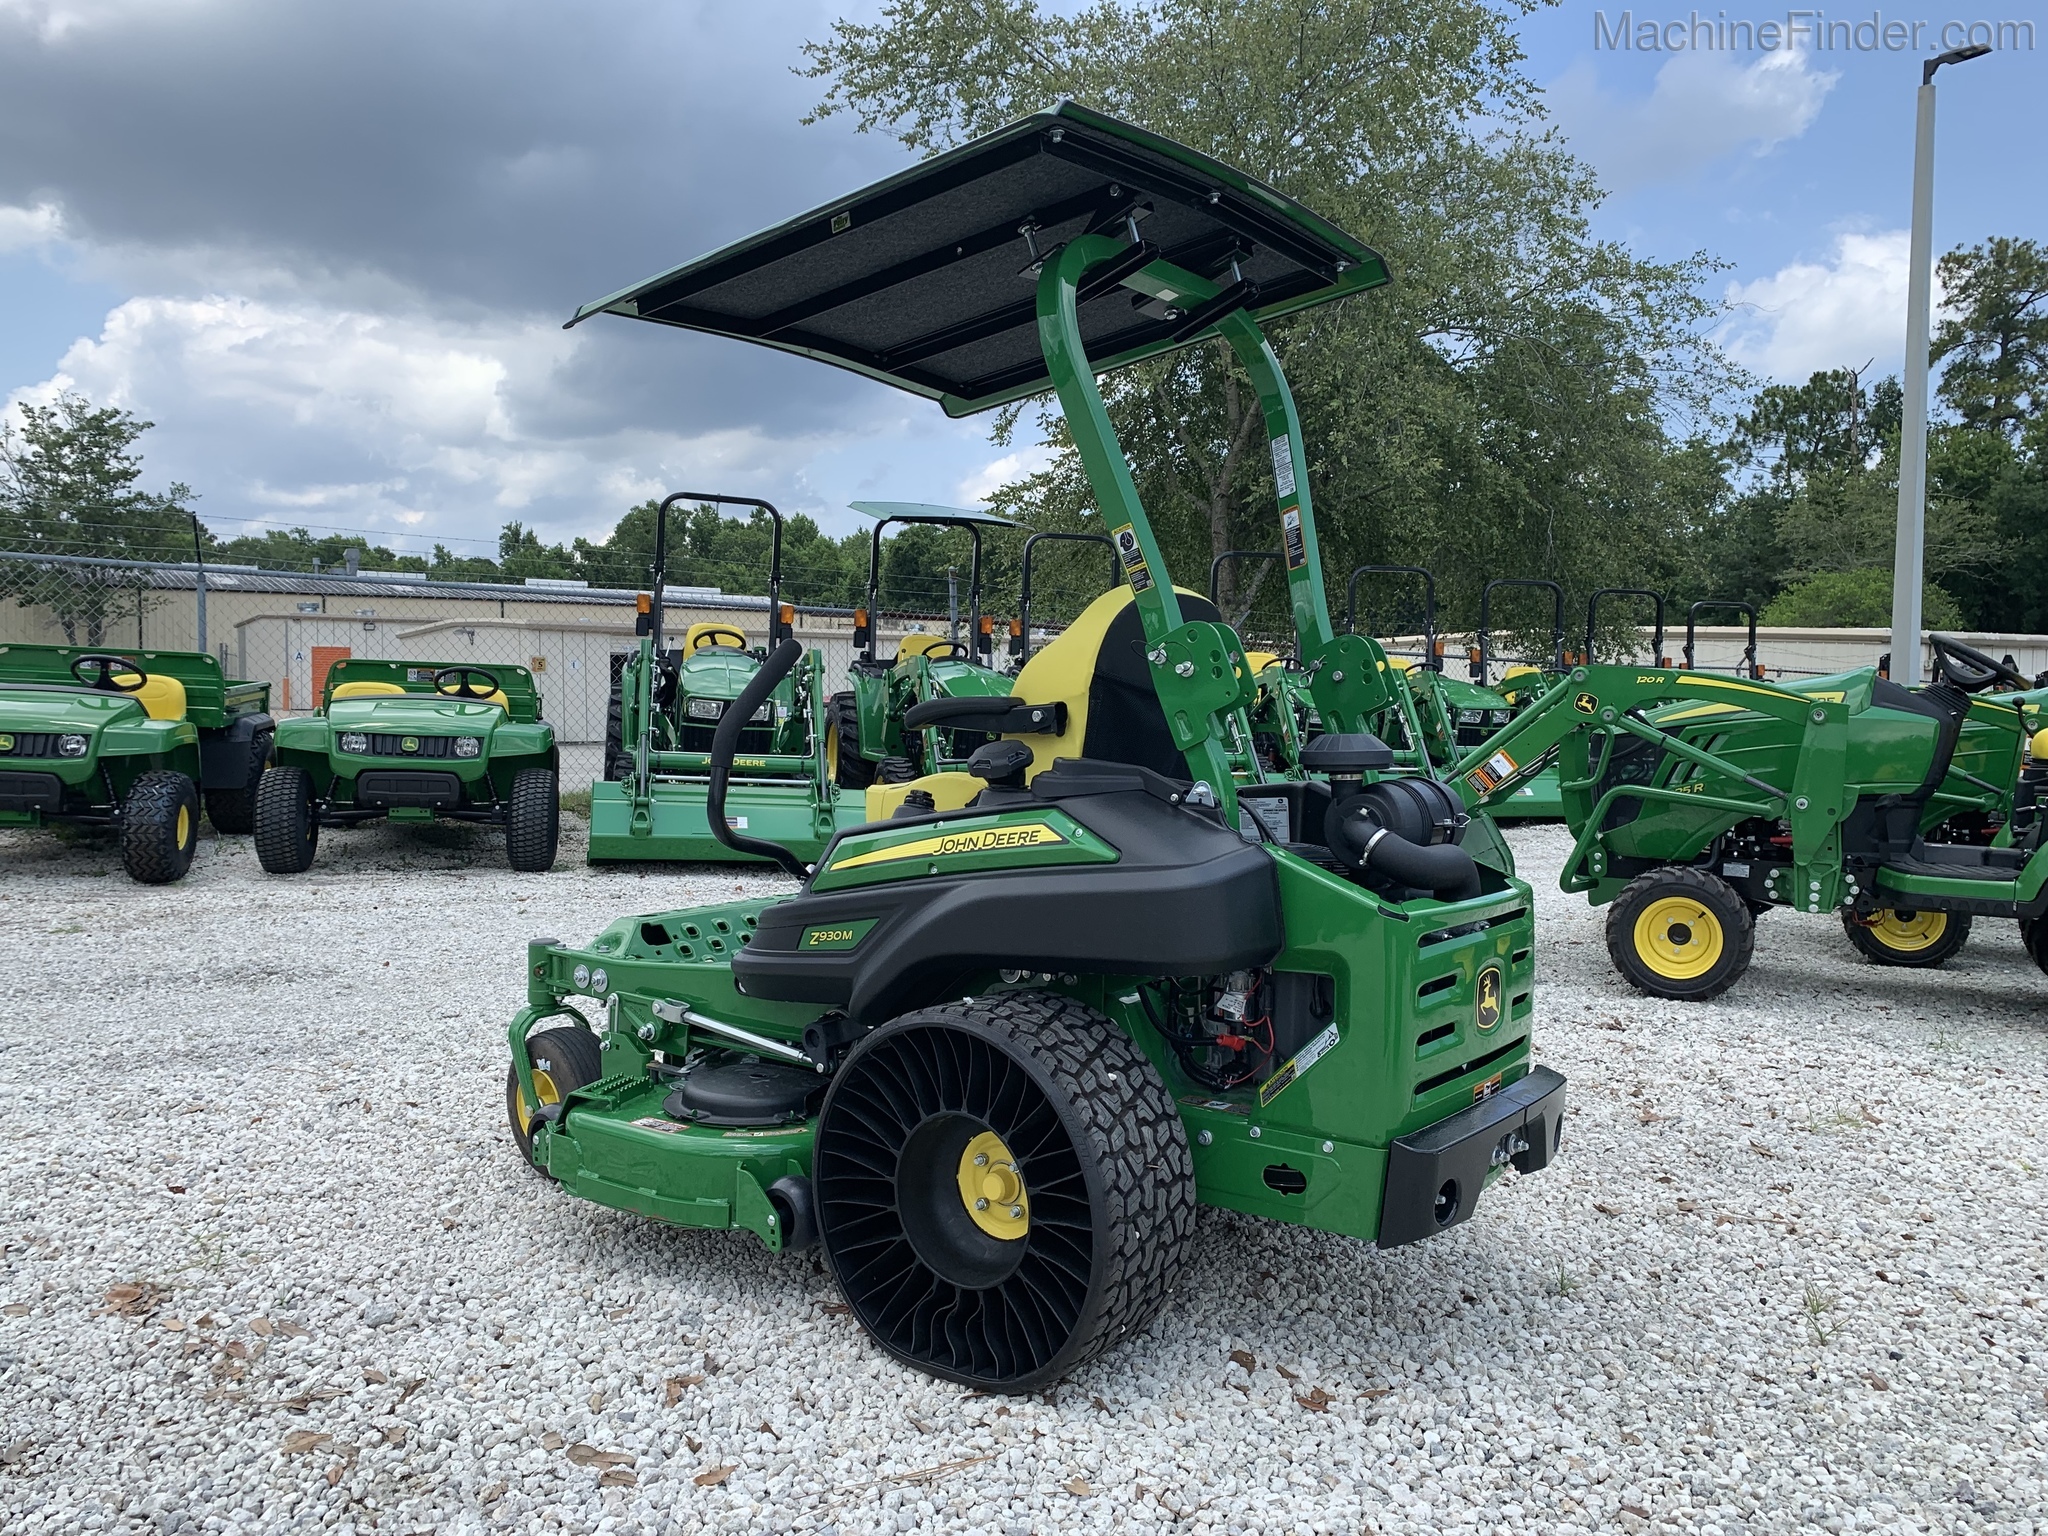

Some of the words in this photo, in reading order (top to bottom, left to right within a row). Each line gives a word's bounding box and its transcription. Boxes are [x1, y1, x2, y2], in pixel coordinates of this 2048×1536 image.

[732, 758, 767, 767] DEERE
[933, 836, 980, 854] JOHN
[982, 830, 1042, 847] DEERE
[809, 930, 853, 945] Z930M
